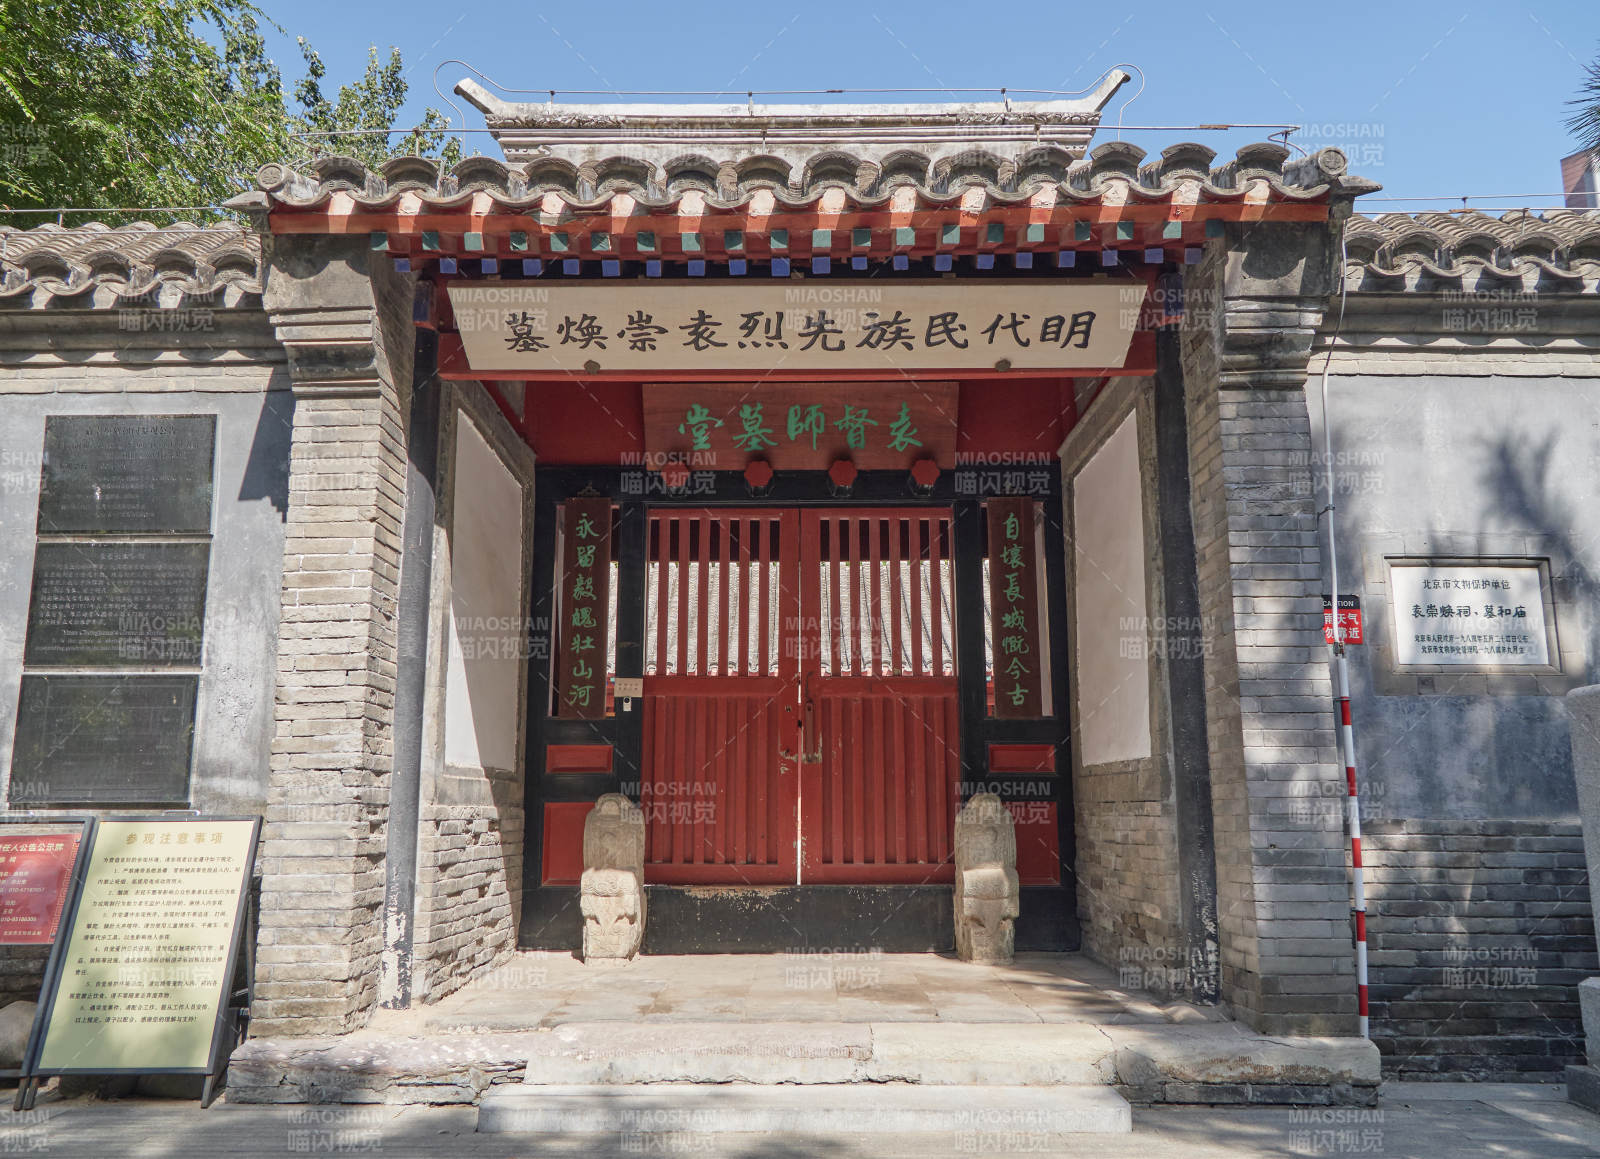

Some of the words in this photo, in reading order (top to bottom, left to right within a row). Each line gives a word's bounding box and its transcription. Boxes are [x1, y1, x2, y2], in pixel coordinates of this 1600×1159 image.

[678, 401, 924, 452] 袁督師墓堂
[1422, 579, 1512, 590] 北京市文物保护单位
[1411, 604, 1527, 619] 袁崇焕祠、墓和庙
[125, 832, 224, 845] 参观注意事项
